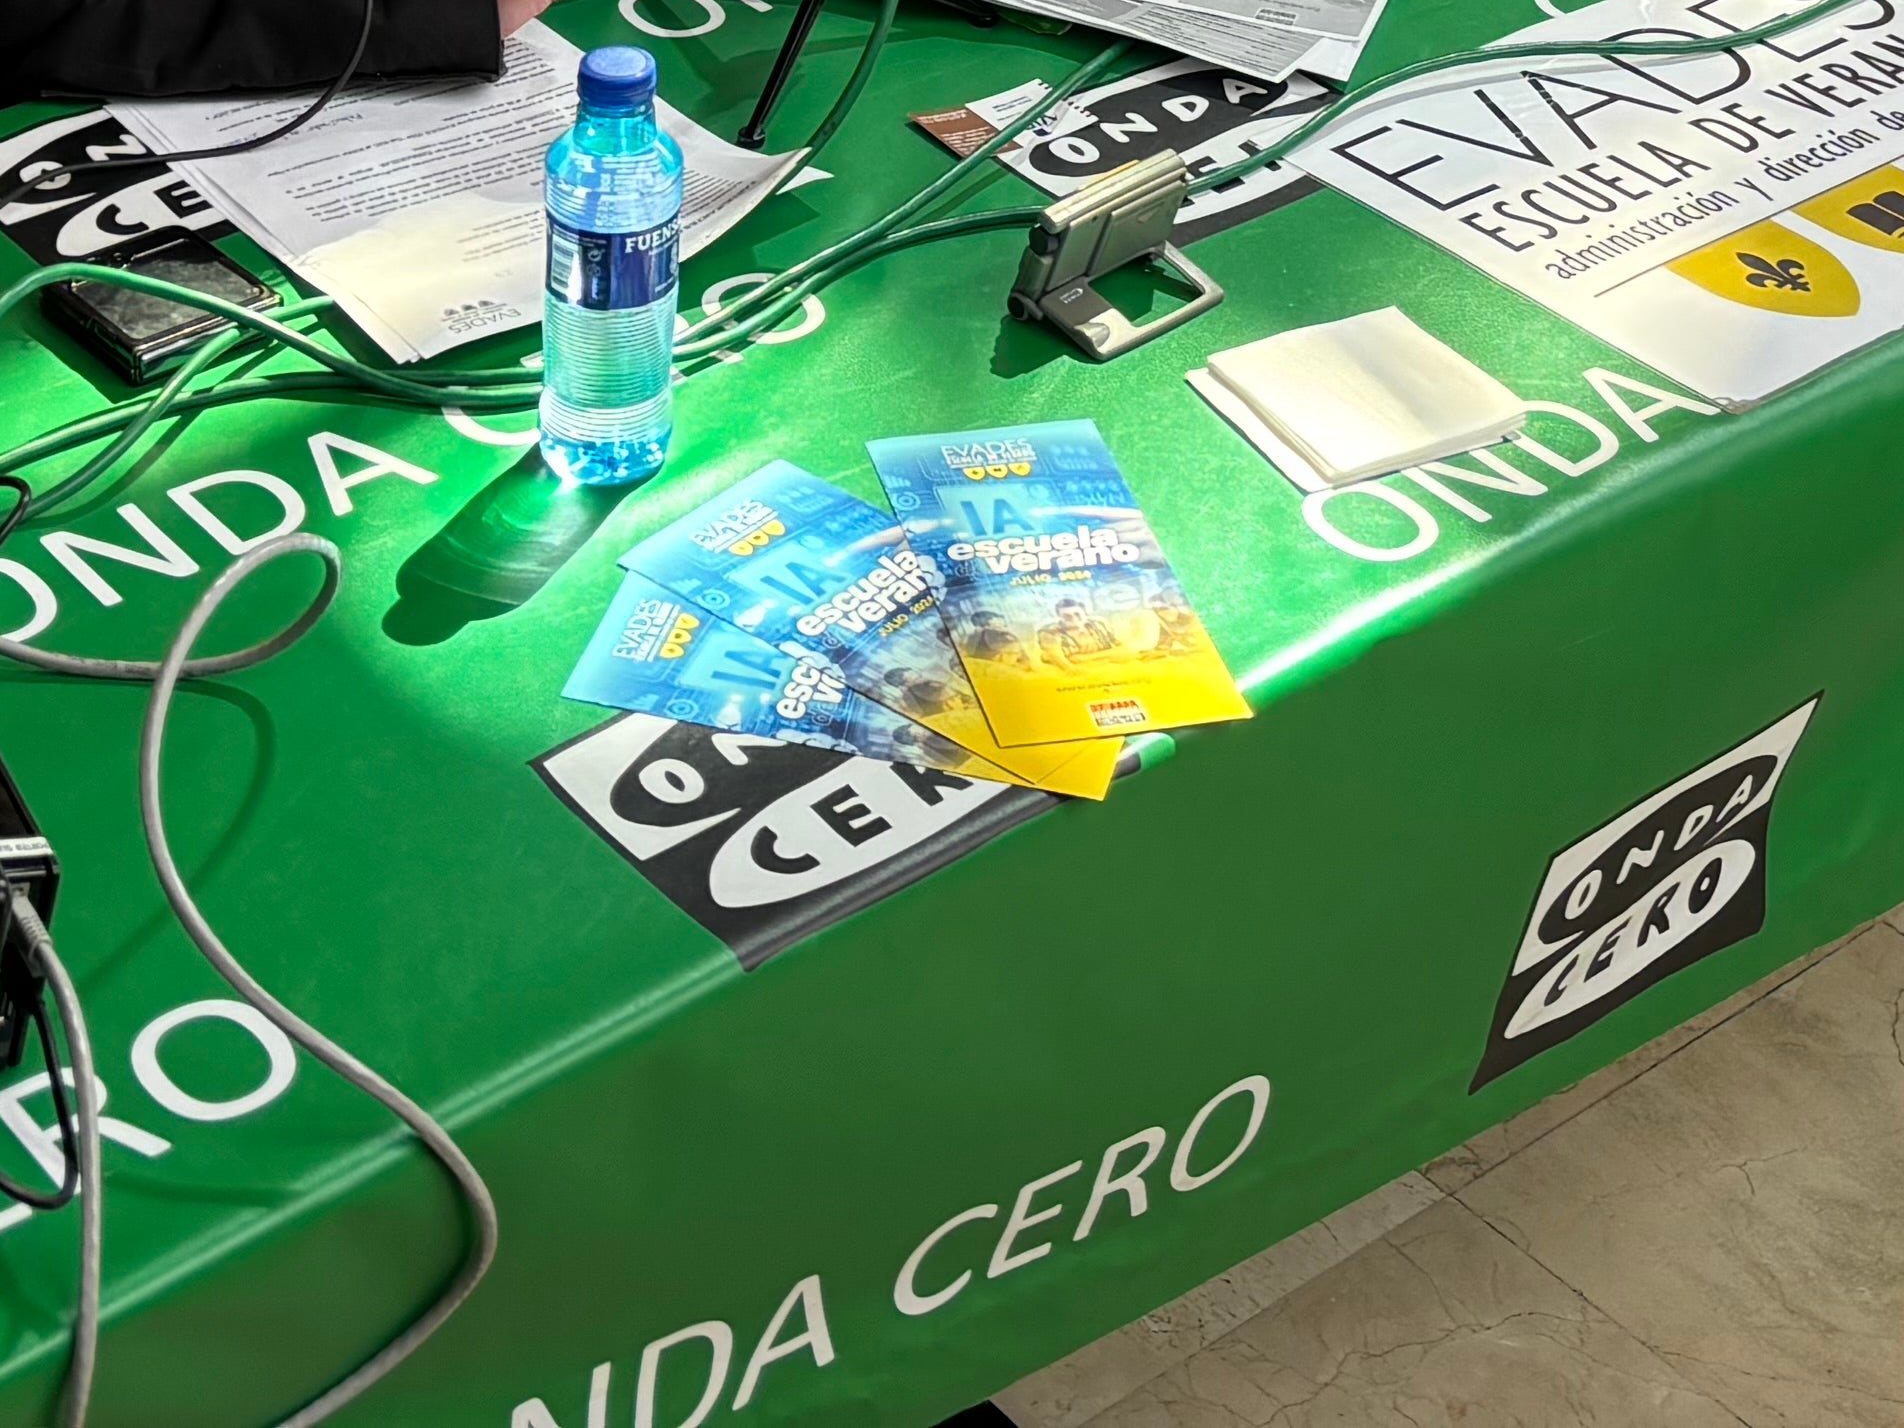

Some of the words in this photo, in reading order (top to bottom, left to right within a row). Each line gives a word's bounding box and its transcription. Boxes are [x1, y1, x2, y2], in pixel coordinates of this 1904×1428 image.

[1049, 78, 1269, 164] ONDA
[1457, 139, 1711, 253] ESCUELA
[1687, 100, 1797, 154] DE
[1544, 186, 1741, 282] administración
[1744, 178, 1771, 203] y
[1763, 123, 1882, 184] dirección
[624, 219, 681, 254] FUENS
[448, 307, 521, 335] EVADES
[1301, 365, 1720, 564] ONDA
[947, 525, 1119, 562] escuela
[958, 496, 1034, 537] IA
[986, 542, 1140, 575] verano
[759, 560, 848, 605] IA
[796, 550, 918, 637] escuela
[612, 598, 660, 658] EVADES
[749, 762, 975, 876] CER
[1567, 770, 1756, 915] ONDA
[1546, 863, 1725, 1005] CERO
[508, 1273, 838, 1428] NDA
[893, 1074, 1272, 1317] CERO
